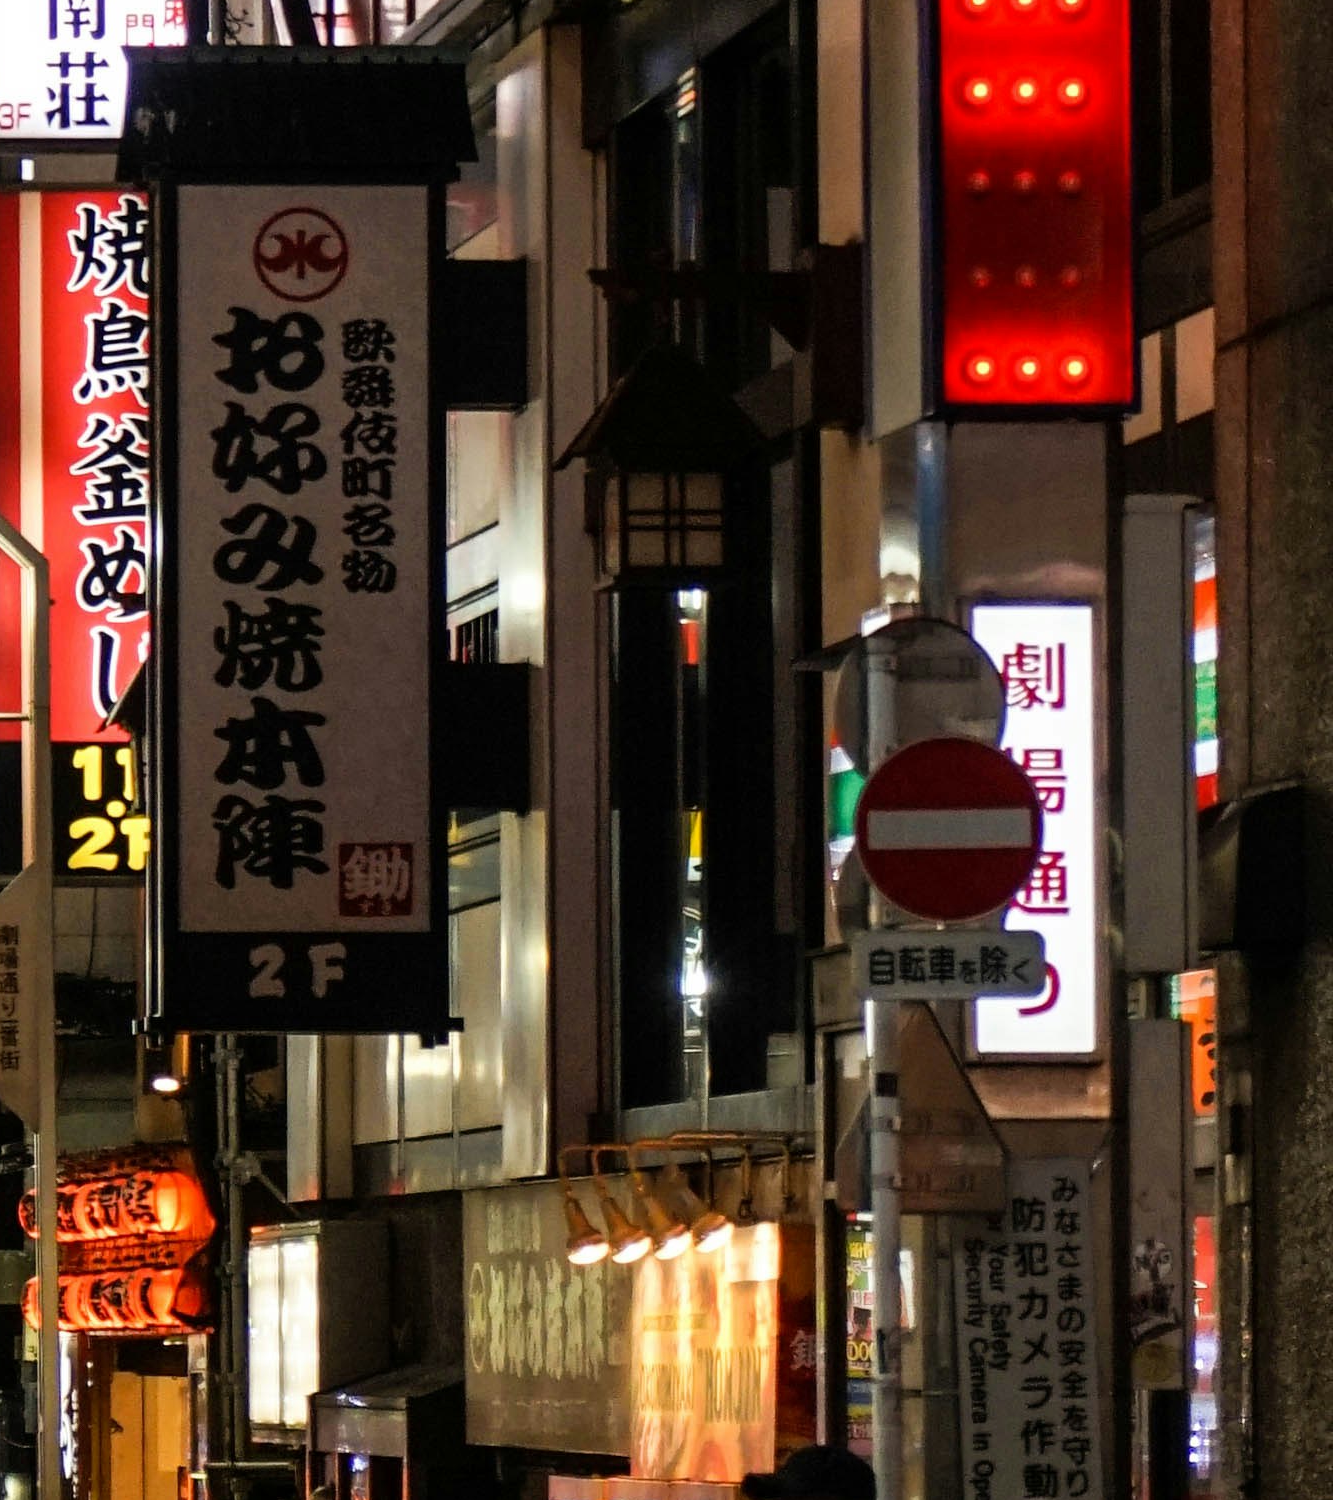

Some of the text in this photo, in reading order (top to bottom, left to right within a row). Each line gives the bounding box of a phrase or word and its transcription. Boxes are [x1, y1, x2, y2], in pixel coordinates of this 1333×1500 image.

[339, 316, 397, 595] 歌舞伎町名物
[210, 305, 329, 891] お好み焼本陣
[247, 941, 348, 999] 2F
[868, 944, 1031, 986] 自転車を除く
[963, 1237, 986, 1329] Security
[989, 1243, 1014, 1373] Your Safety
[967, 1331, 989, 1429] Camera
[971, 1430, 989, 1455] in
